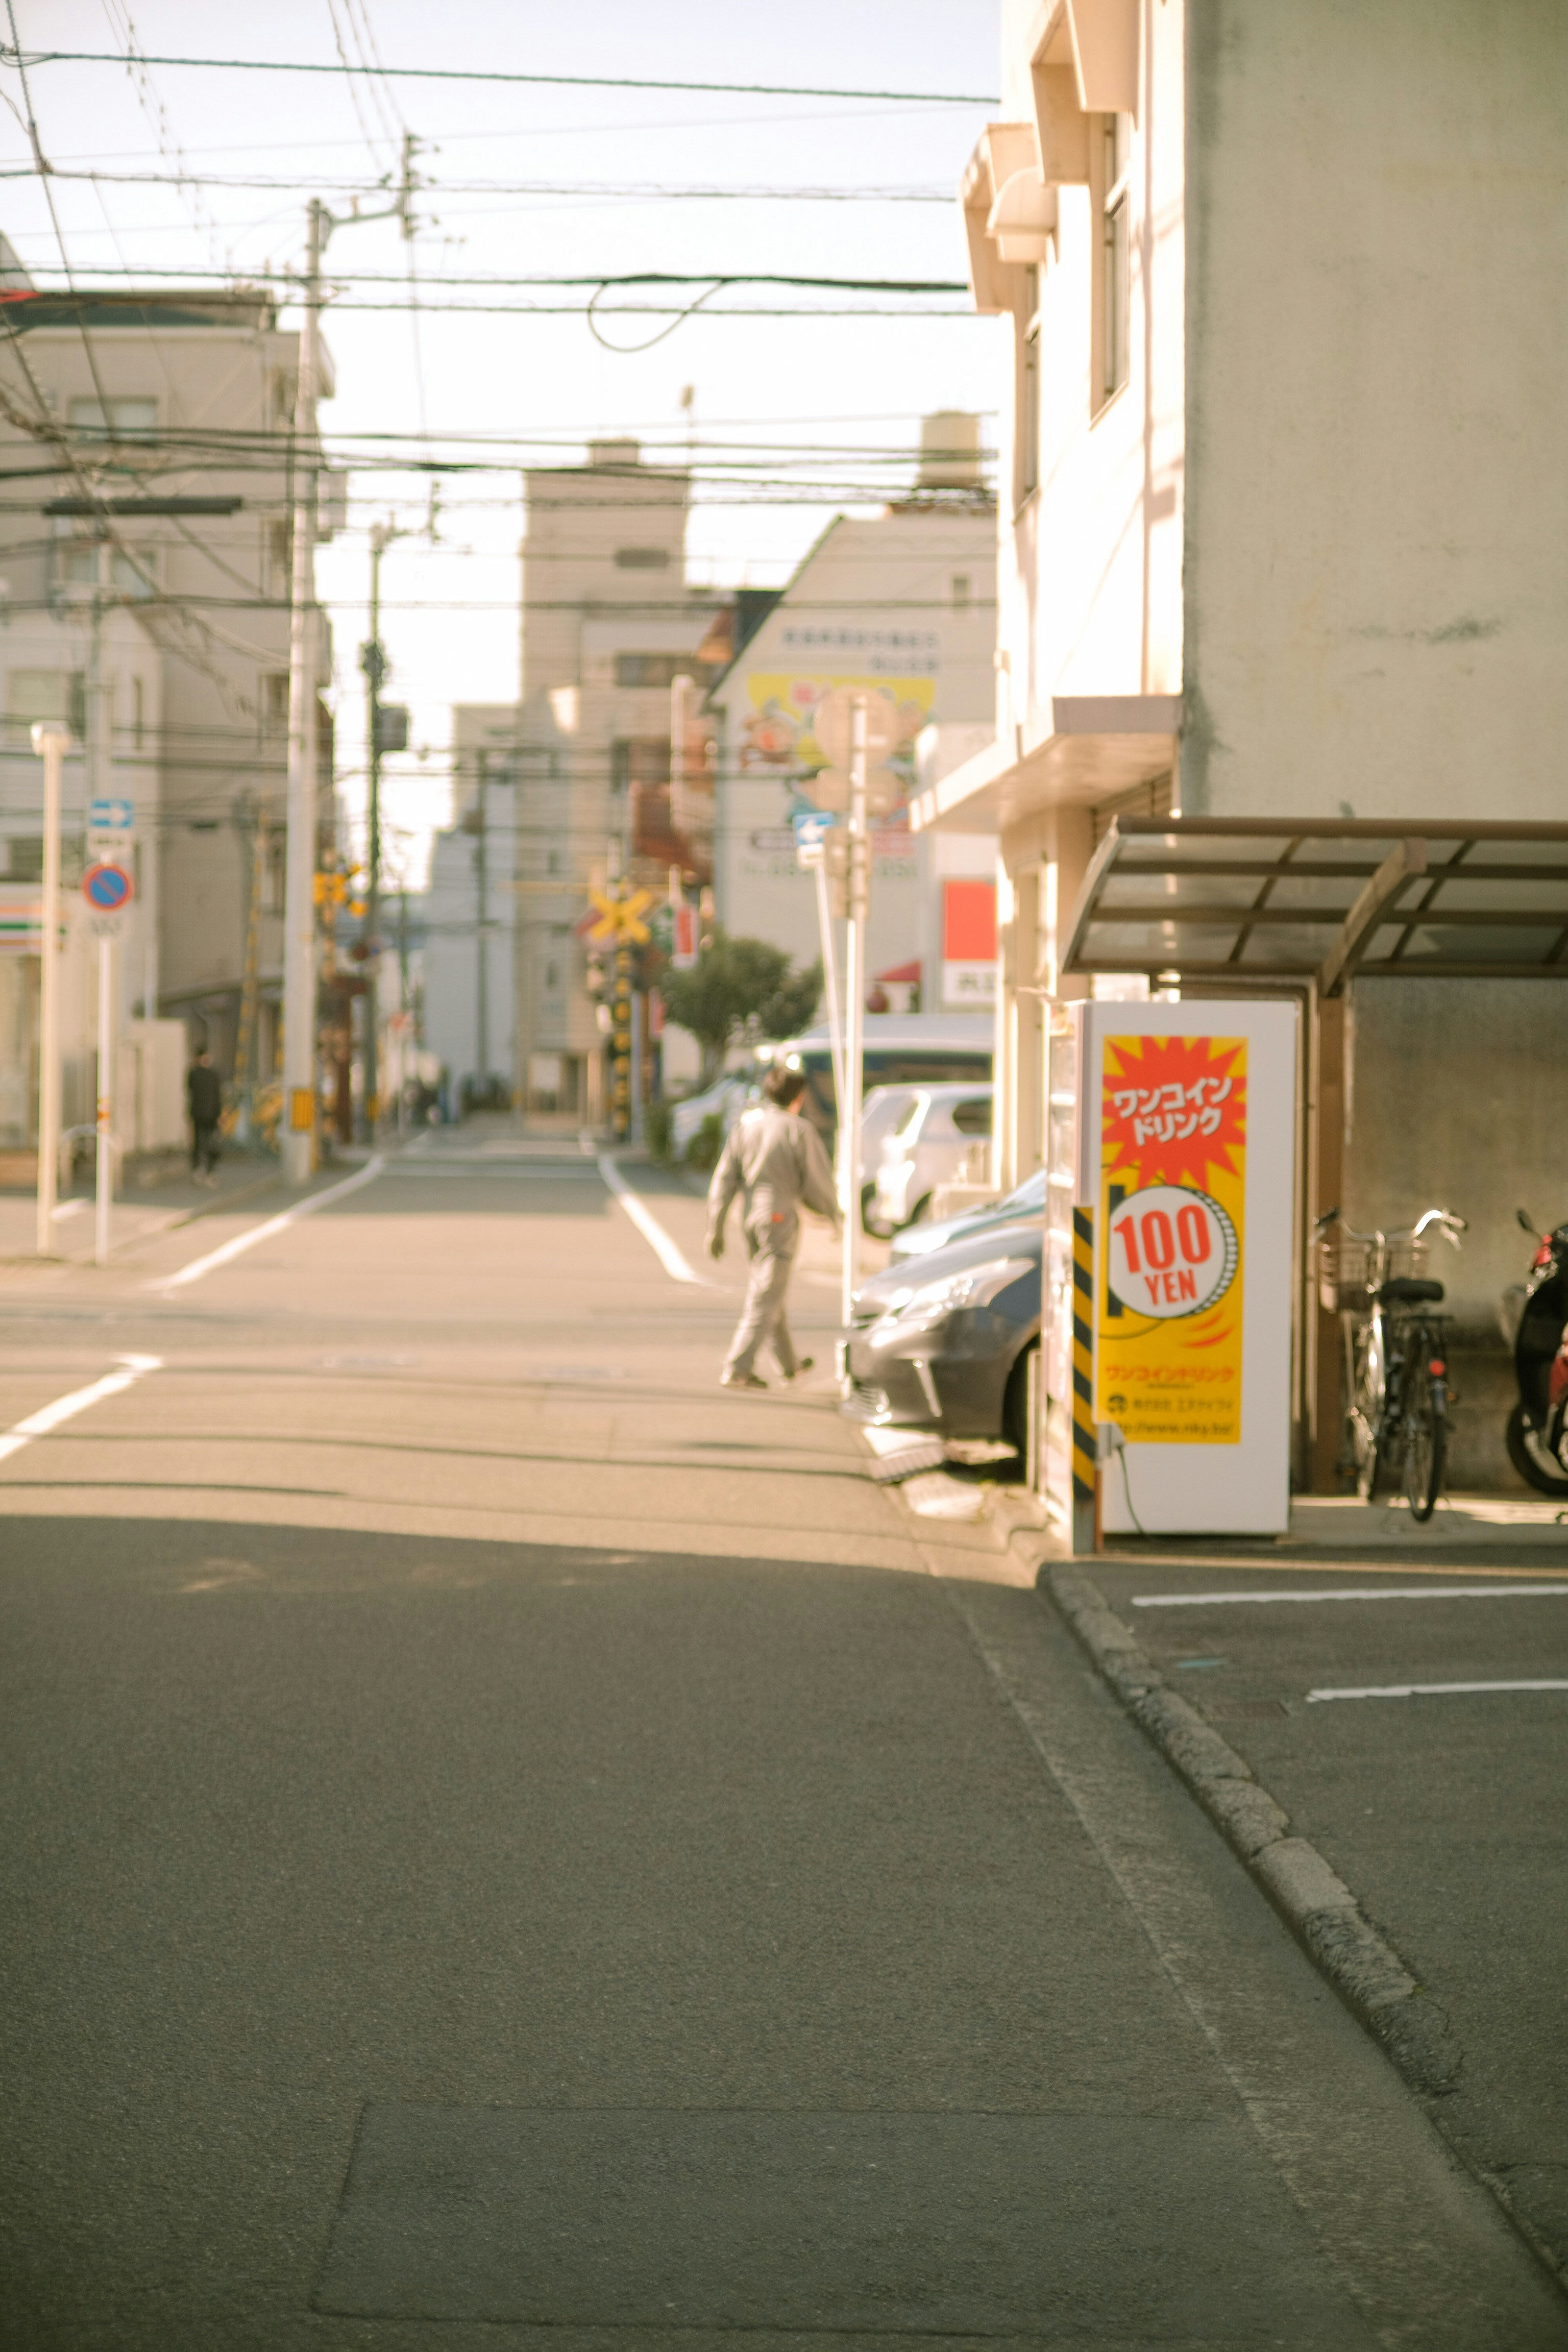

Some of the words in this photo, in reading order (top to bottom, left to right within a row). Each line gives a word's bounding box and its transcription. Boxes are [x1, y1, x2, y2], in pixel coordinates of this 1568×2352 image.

[1113, 1076, 1232, 1119] ワンコイン
[1133, 1106, 1222, 1147] ドリンク
[1113, 1205, 1212, 1274] 100
[1144, 1268, 1197, 1306] YEN
